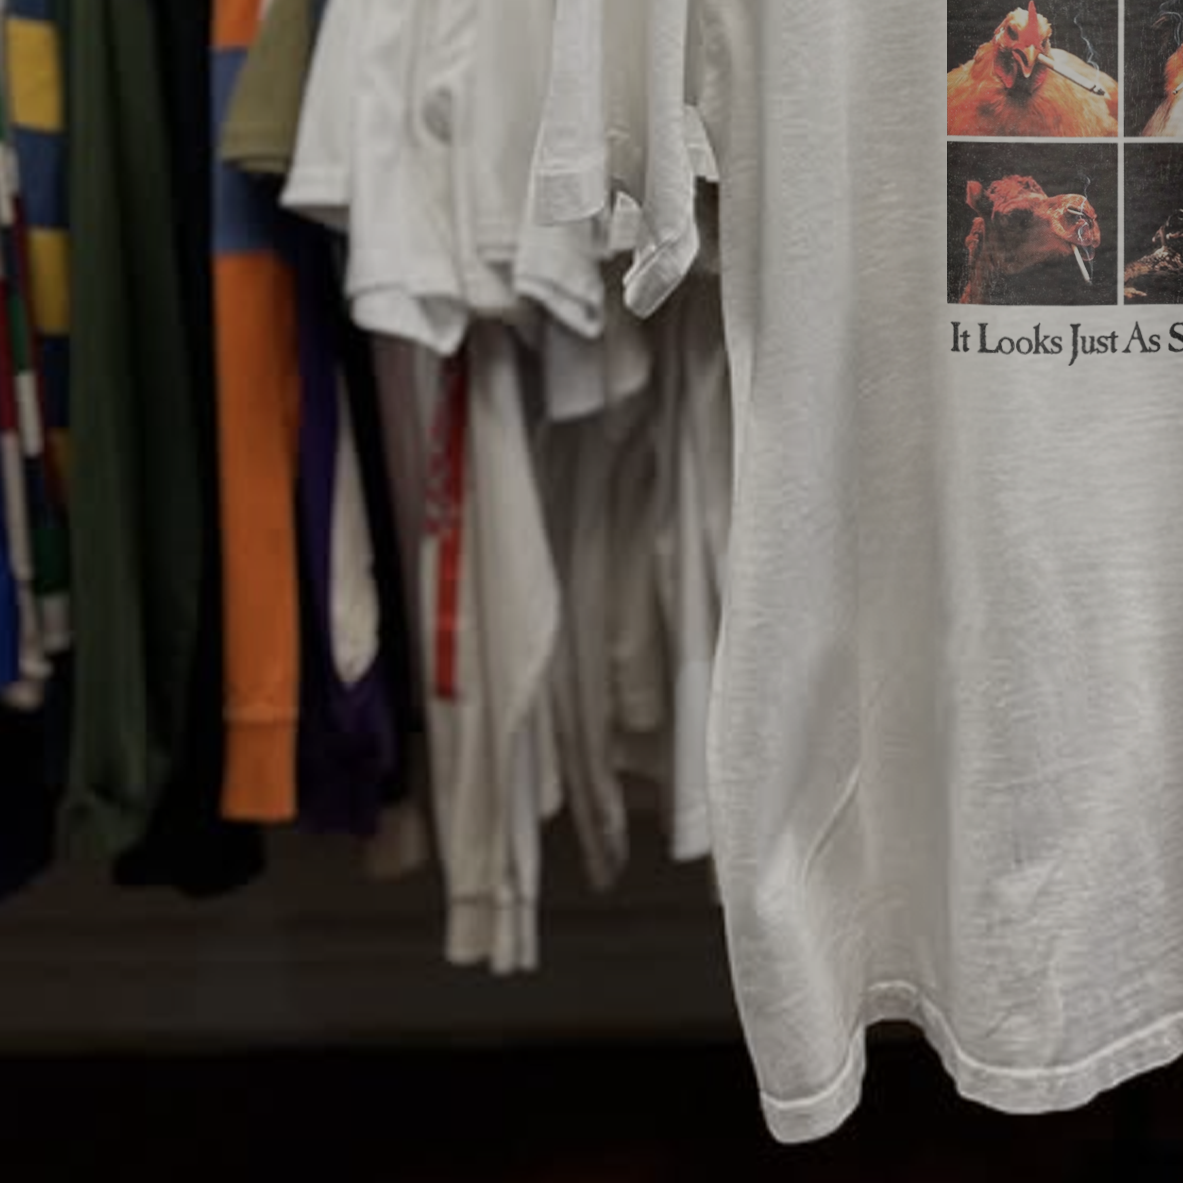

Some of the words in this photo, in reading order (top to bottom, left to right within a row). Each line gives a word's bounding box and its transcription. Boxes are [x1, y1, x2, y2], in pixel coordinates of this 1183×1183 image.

[949, 320, 972, 354] It
[977, 321, 1064, 355] Looks
[1067, 322, 1120, 367] Just
[1121, 320, 1162, 354] As
